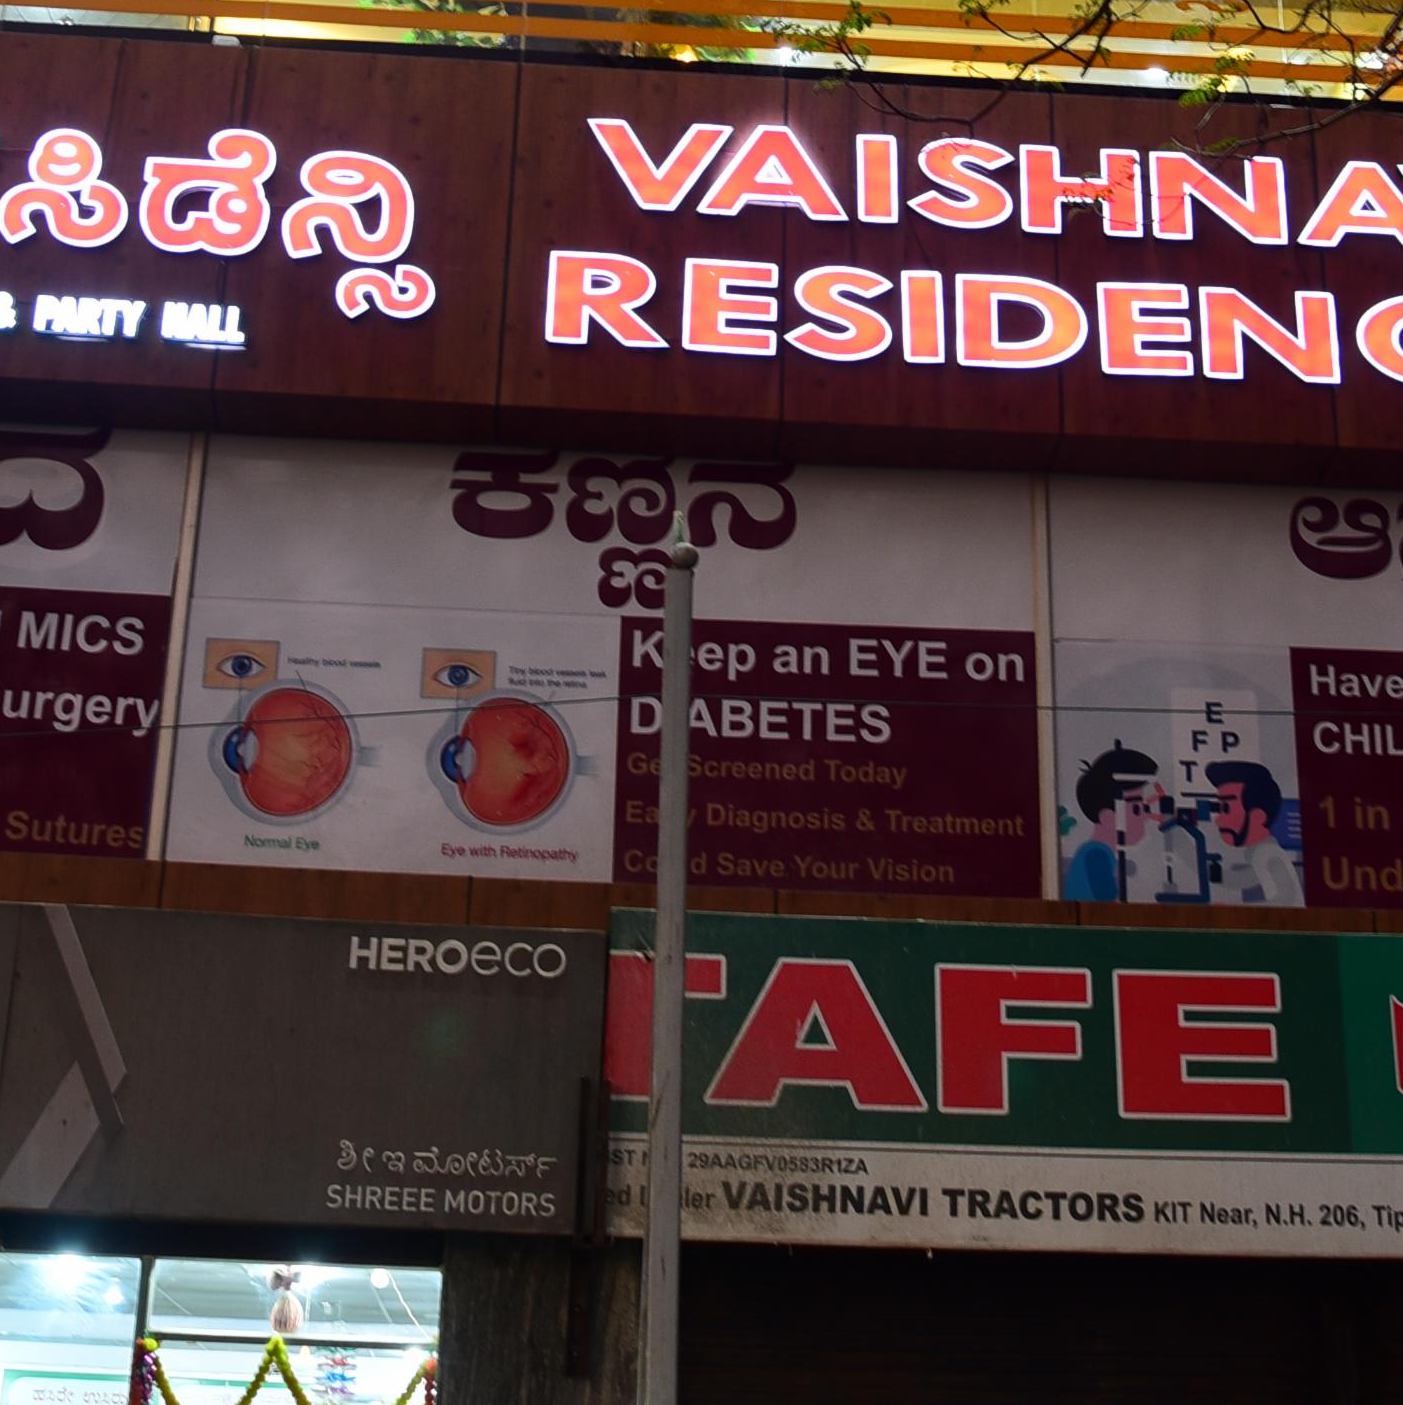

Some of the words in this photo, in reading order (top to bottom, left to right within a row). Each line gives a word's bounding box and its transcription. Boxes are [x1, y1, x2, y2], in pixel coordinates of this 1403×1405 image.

[34, 294, 146, 338] PARTY
[161, 302, 246, 344] HALL
[17, 611, 145, 656] MICS
[632, 629, 756, 681] Kep
[772, 641, 831, 677] an
[849, 638, 948, 680] EYE
[965, 651, 1025, 682] on
[629, 695, 892, 743] DABETES
[1205, 702, 1224, 724] E
[1192, 730, 1208, 752] F
[1221, 731, 1240, 753] P
[626, 752, 662, 778] Ge
[686, 754, 815, 782] Screened
[824, 759, 908, 788] Today
[707, 803, 846, 835] Diagnosis
[855, 808, 876, 832] &
[885, 810, 1025, 836] Treatment
[1318, 797, 1336, 829] 1
[1354, 797, 1390, 830] in
[5, 811, 145, 851] Sutures
[244, 835, 292, 850] Normal
[296, 837, 320, 852] Eye
[441, 843, 465, 858] Eye
[468, 844, 497, 859] with
[500, 845, 578, 863] Retinopathy
[623, 849, 706, 875] Cod
[717, 852, 784, 880] Save
[794, 856, 861, 880] Your
[869, 857, 954, 883] Vision
[687, 1151, 869, 1175] 29AAGFV0583R1ZA
[325, 1184, 435, 1213] SHREEE
[444, 1189, 556, 1218] MOTORS
[722, 1180, 929, 1218] VAISHNAVI
[943, 1187, 1145, 1224] TRACTORS
[1153, 1200, 1193, 1225] KIT
[1199, 1203, 1258, 1230] Near,
[1263, 1204, 1313, 1229] N.H.
[1320, 1205, 1367, 1232] 206,
